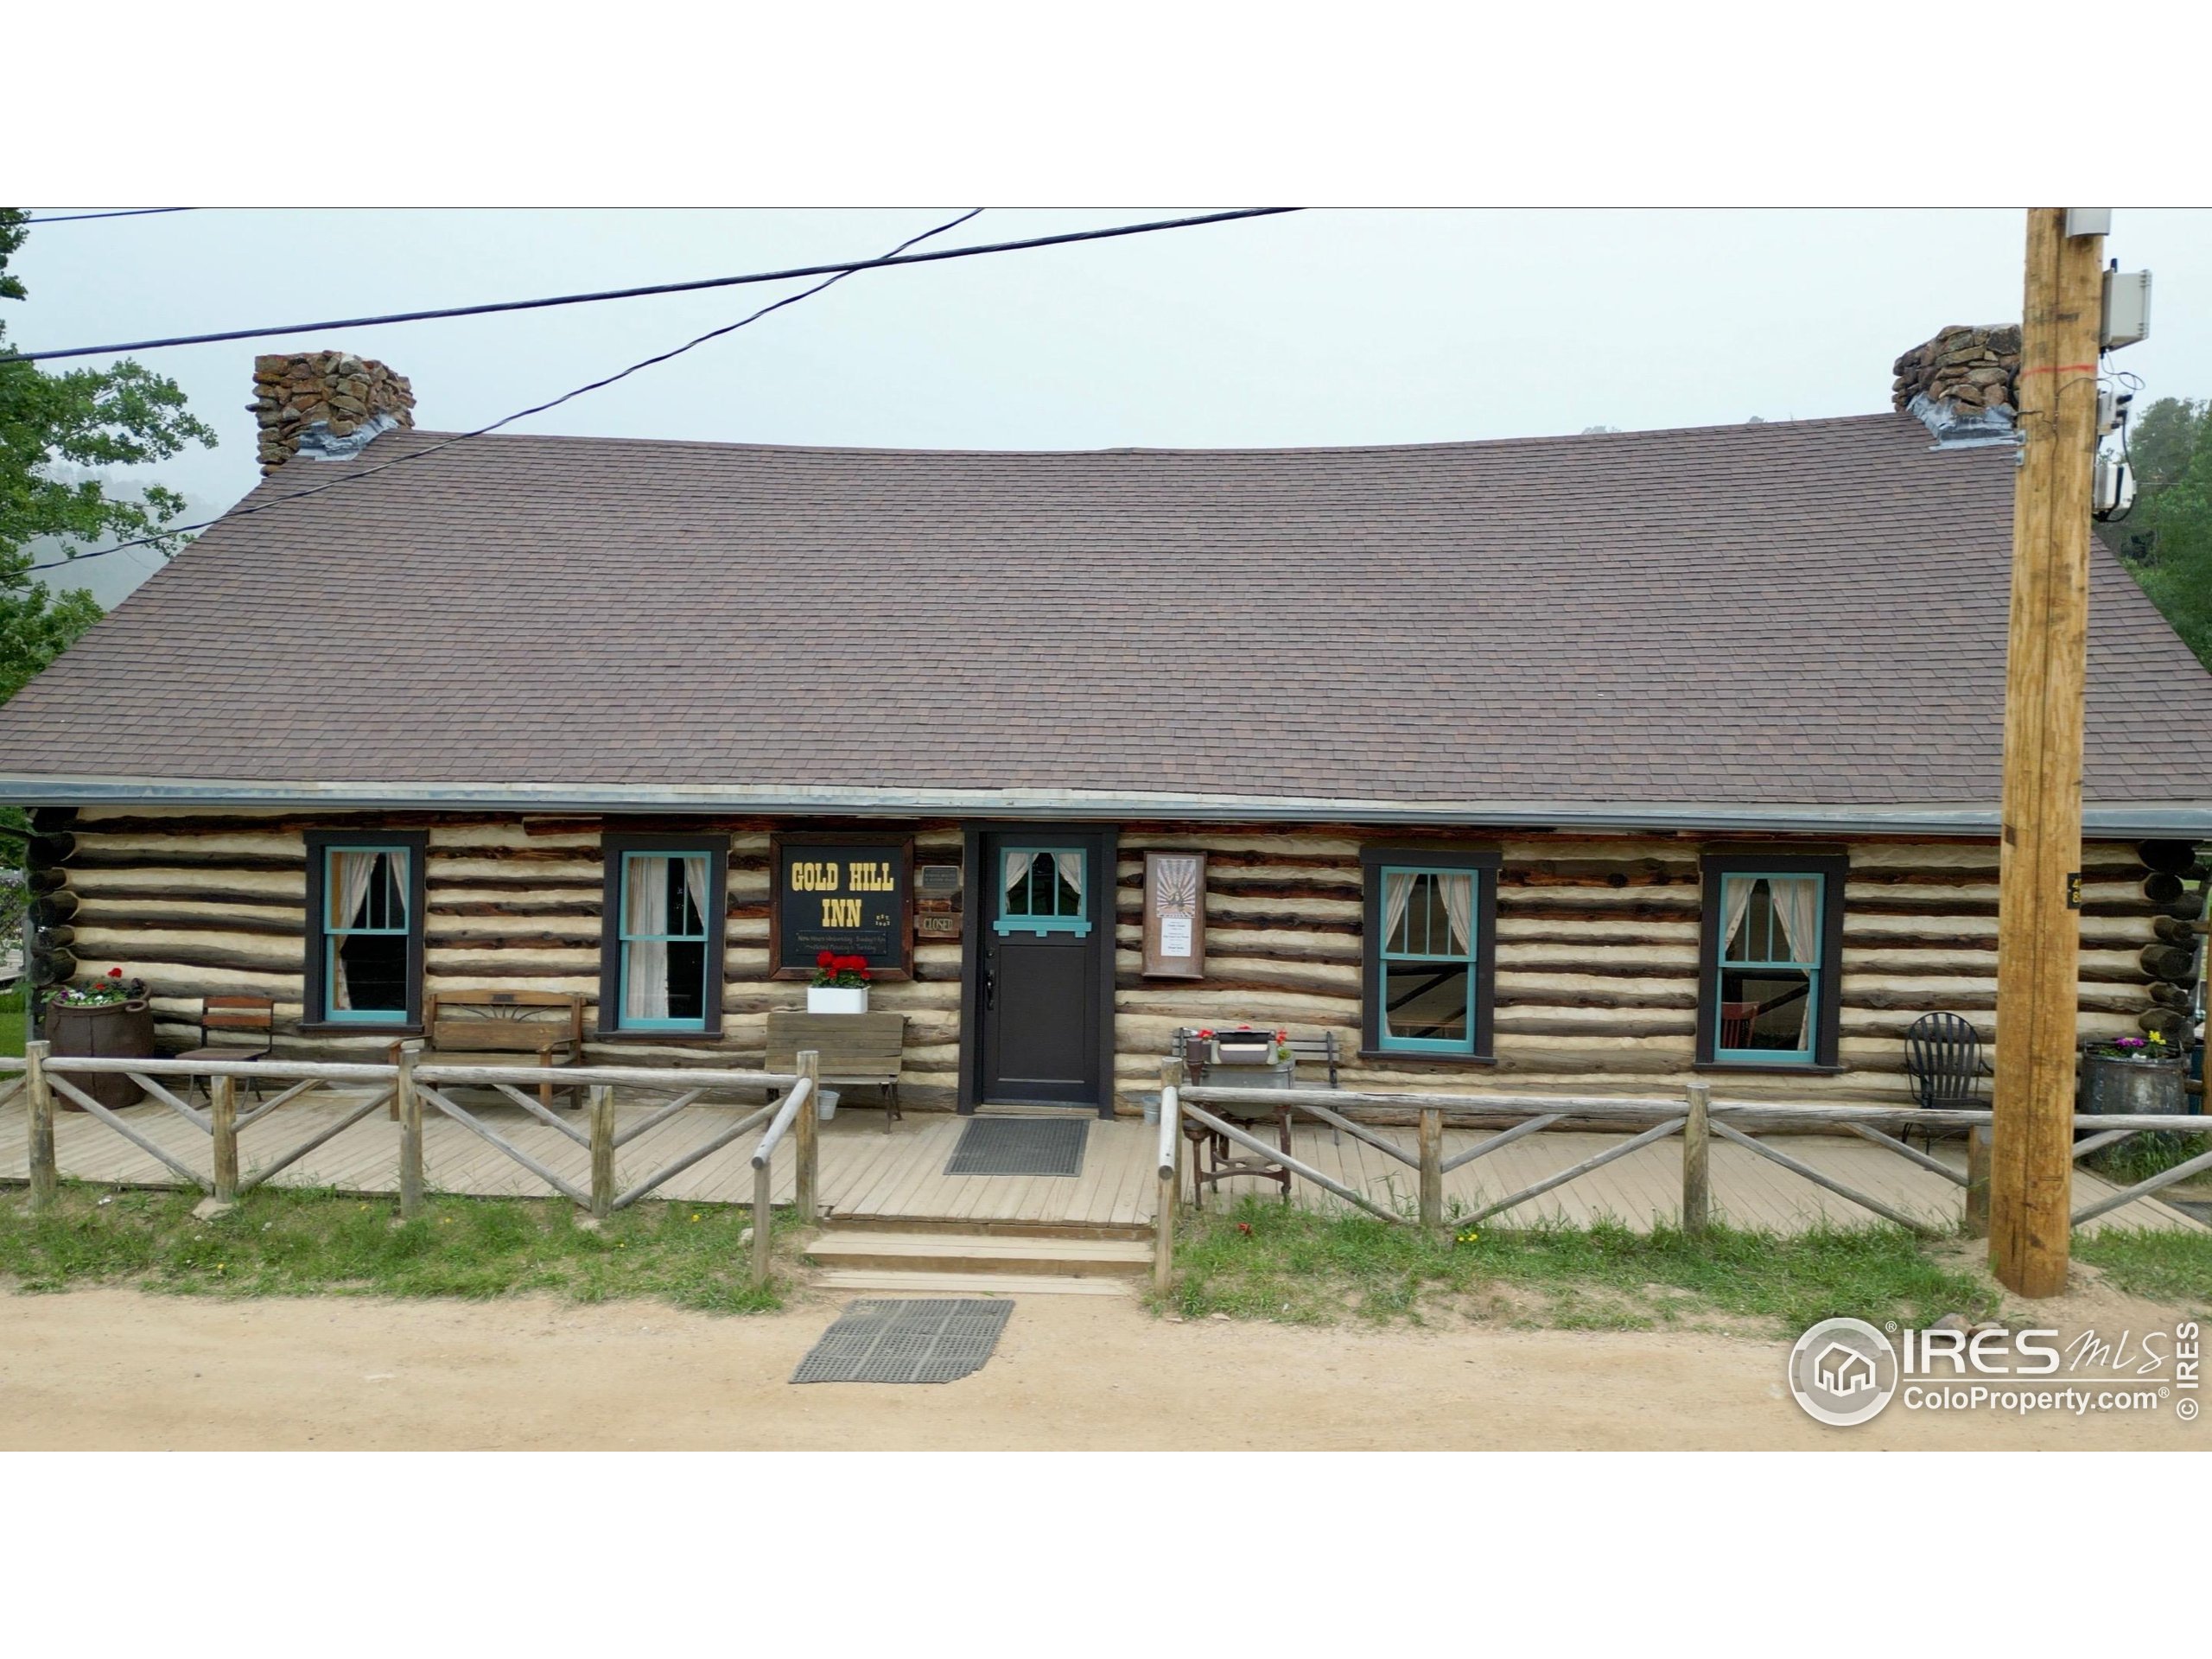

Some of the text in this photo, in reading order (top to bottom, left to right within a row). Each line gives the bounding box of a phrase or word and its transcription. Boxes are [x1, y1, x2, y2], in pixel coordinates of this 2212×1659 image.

[791, 862, 839, 892] GOLD
[849, 862, 894, 892] HILL
[822, 899, 862, 928] INN
[924, 918, 953, 931] CLOSED
